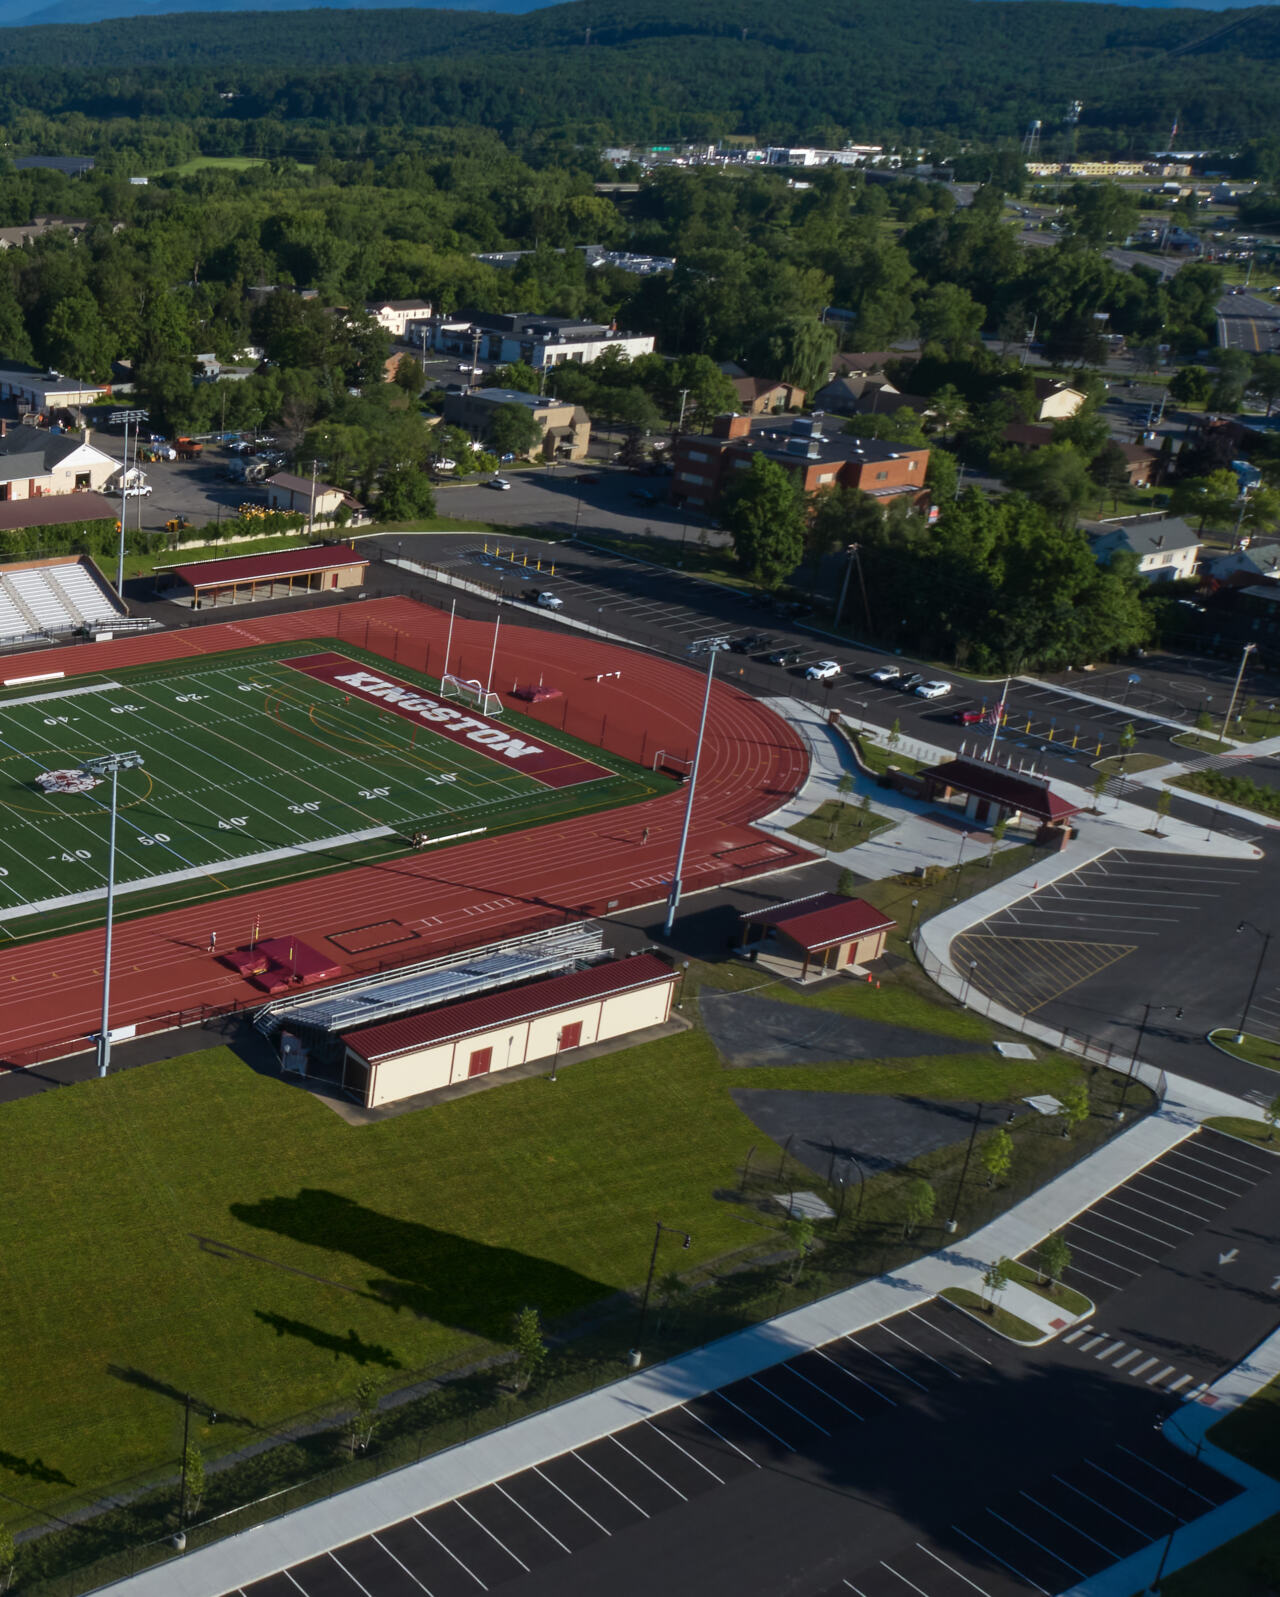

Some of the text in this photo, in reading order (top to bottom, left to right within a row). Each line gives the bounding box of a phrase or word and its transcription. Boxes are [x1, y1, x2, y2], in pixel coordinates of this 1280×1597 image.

[175, 693, 203, 703] 20
[110, 704, 138, 714] 30
[334, 671, 544, 759] KINGSTON
[43, 715, 72, 726] 40
[424, 773, 457, 785] 10
[358, 787, 390, 800] 20
[287, 802, 320, 815] 30
[218, 817, 247, 830] 40
[137, 832, 171, 847] 50
[60, 849, 93, 864] 40
